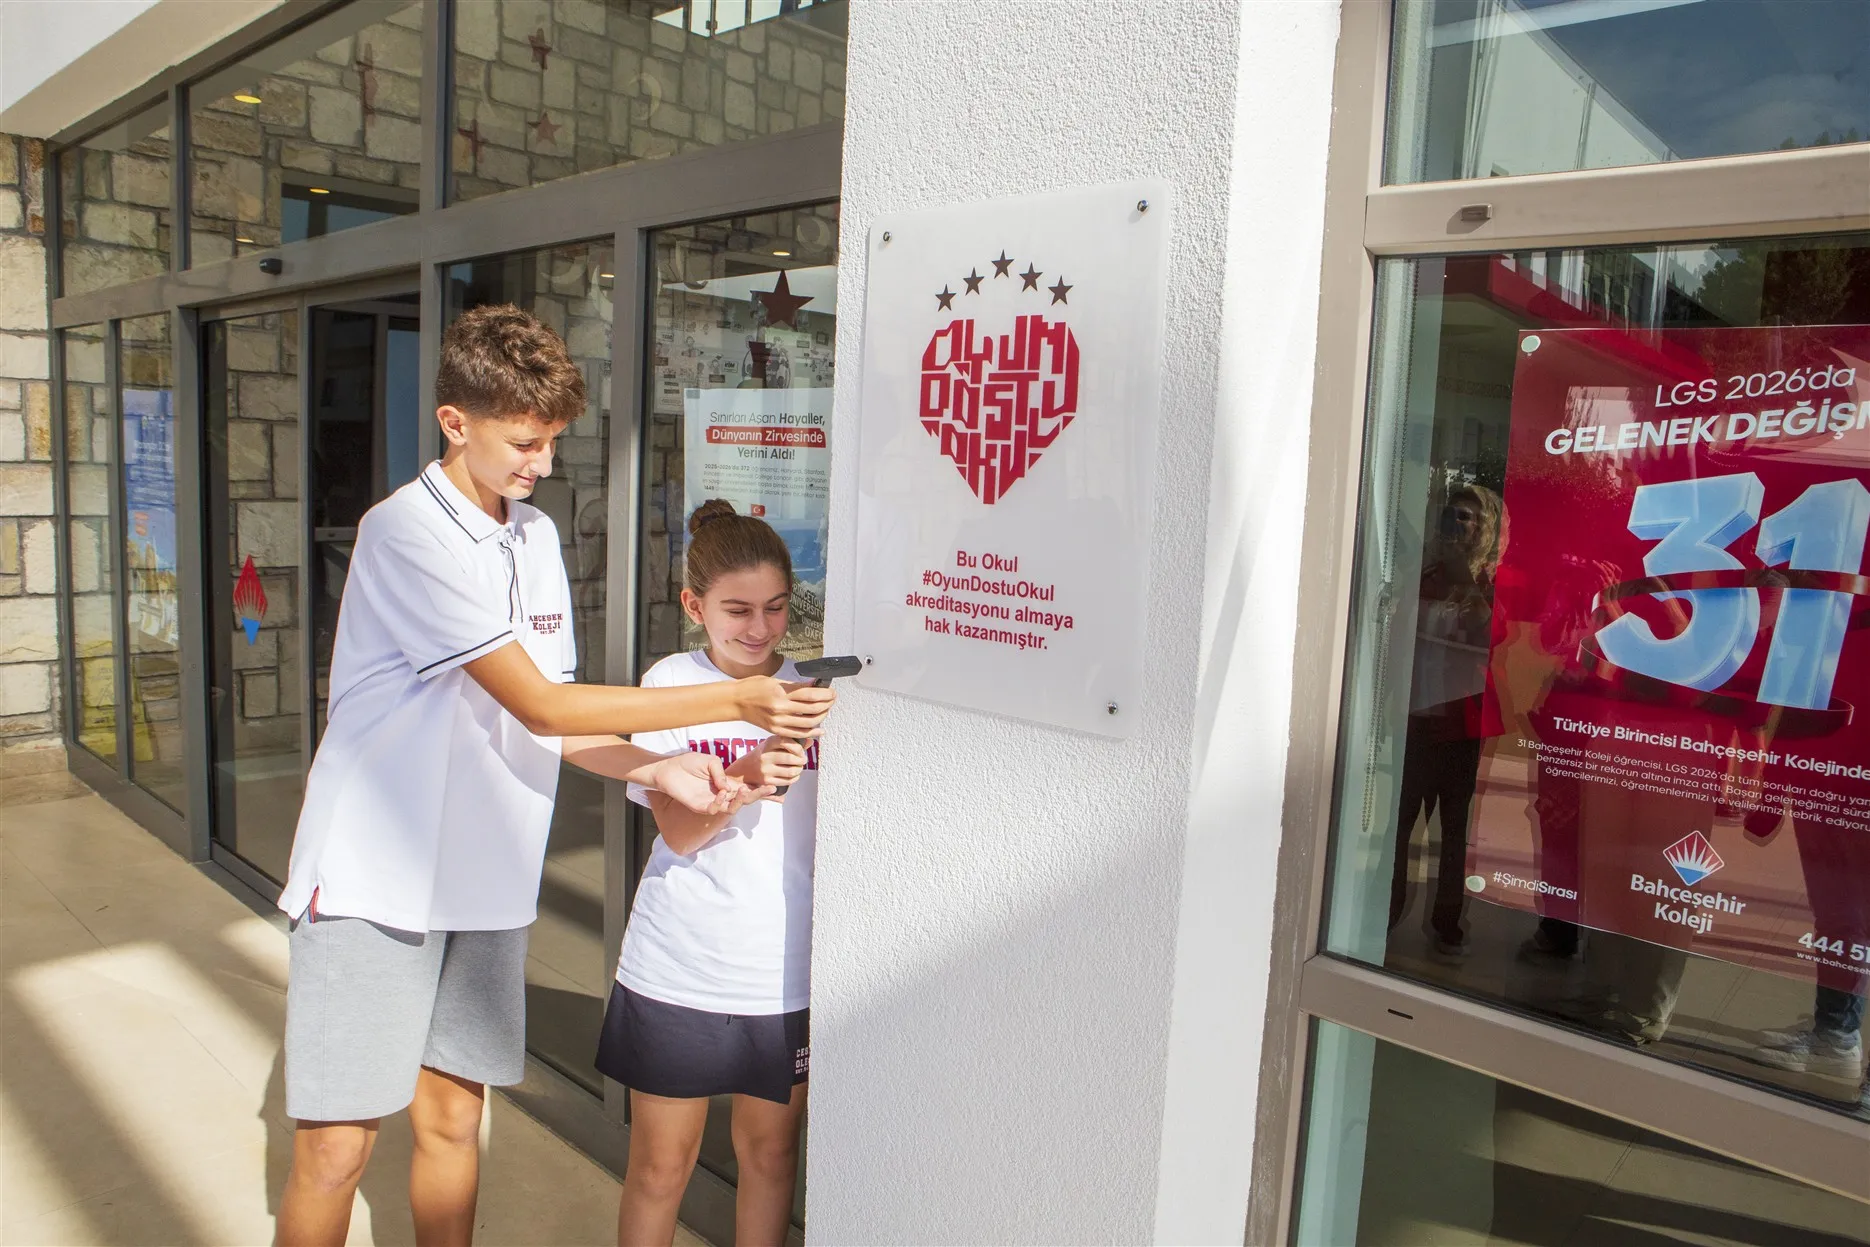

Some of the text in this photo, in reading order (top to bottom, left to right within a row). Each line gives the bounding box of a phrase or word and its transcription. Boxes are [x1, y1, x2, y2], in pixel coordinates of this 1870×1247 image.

[1655, 364, 1857, 408] LGS 2026'da
[710, 411, 826, 427] Sınırları Aşan Hayaller,
[712, 428, 823, 444] Dünyanın Zirvesinde
[1544, 414, 1719, 456] GELENEK
[737, 446, 796, 460] Yerini Aldı!
[956, 549, 1018, 573] Bu Okul
[922, 569, 1055, 602] #OyunDostuOkul
[1595, 471, 1870, 711] 31
[905, 591, 1074, 632] akreditasyonu almaya
[924, 615, 1048, 650] hak kazanmıştır.
[1552, 716, 1611, 739] Türkiye
[1614, 725, 1678, 748] Birincisi
[1680, 736, 1781, 763] Bahçeşehir
[1517, 738, 1527, 748] 31
[1528, 740, 1583, 757] Bahçeşehir
[1584, 749, 1612, 762] Koleji
[1613, 755, 1663, 772] öğrencisi,
[1665, 763, 1688, 775] LGS
[1690, 767, 1735, 783] 2026'da
[1738, 775, 1760, 788] tüm
[1762, 780, 1807, 796] soruları
[1809, 787, 1846, 803] doğru
[1536, 752, 1583, 769] benzersiz
[1585, 761, 1598, 772] bir
[1600, 763, 1639, 779] rekorun
[1640, 771, 1671, 784] altına
[1673, 775, 1700, 788] imza
[1701, 782, 1722, 794] attı.
[1725, 784, 1763, 800] Başarı
[1764, 792, 1840, 815] geleneğimizi
[1545, 765, 1619, 787] öğrencilerimizi,
[1620, 777, 1709, 803] öğretmenlerimizi
[1711, 796, 1726, 806] ve
[1728, 798, 1787, 816] velilerimizi
[1788, 808, 1822, 823] tebrik
[1492, 870, 1578, 901] #ŞimdiSırası
[1630, 873, 1747, 916] Bahçeşehir
[1653, 901, 1714, 934] Koleji
[1798, 932, 1845, 957] 444
